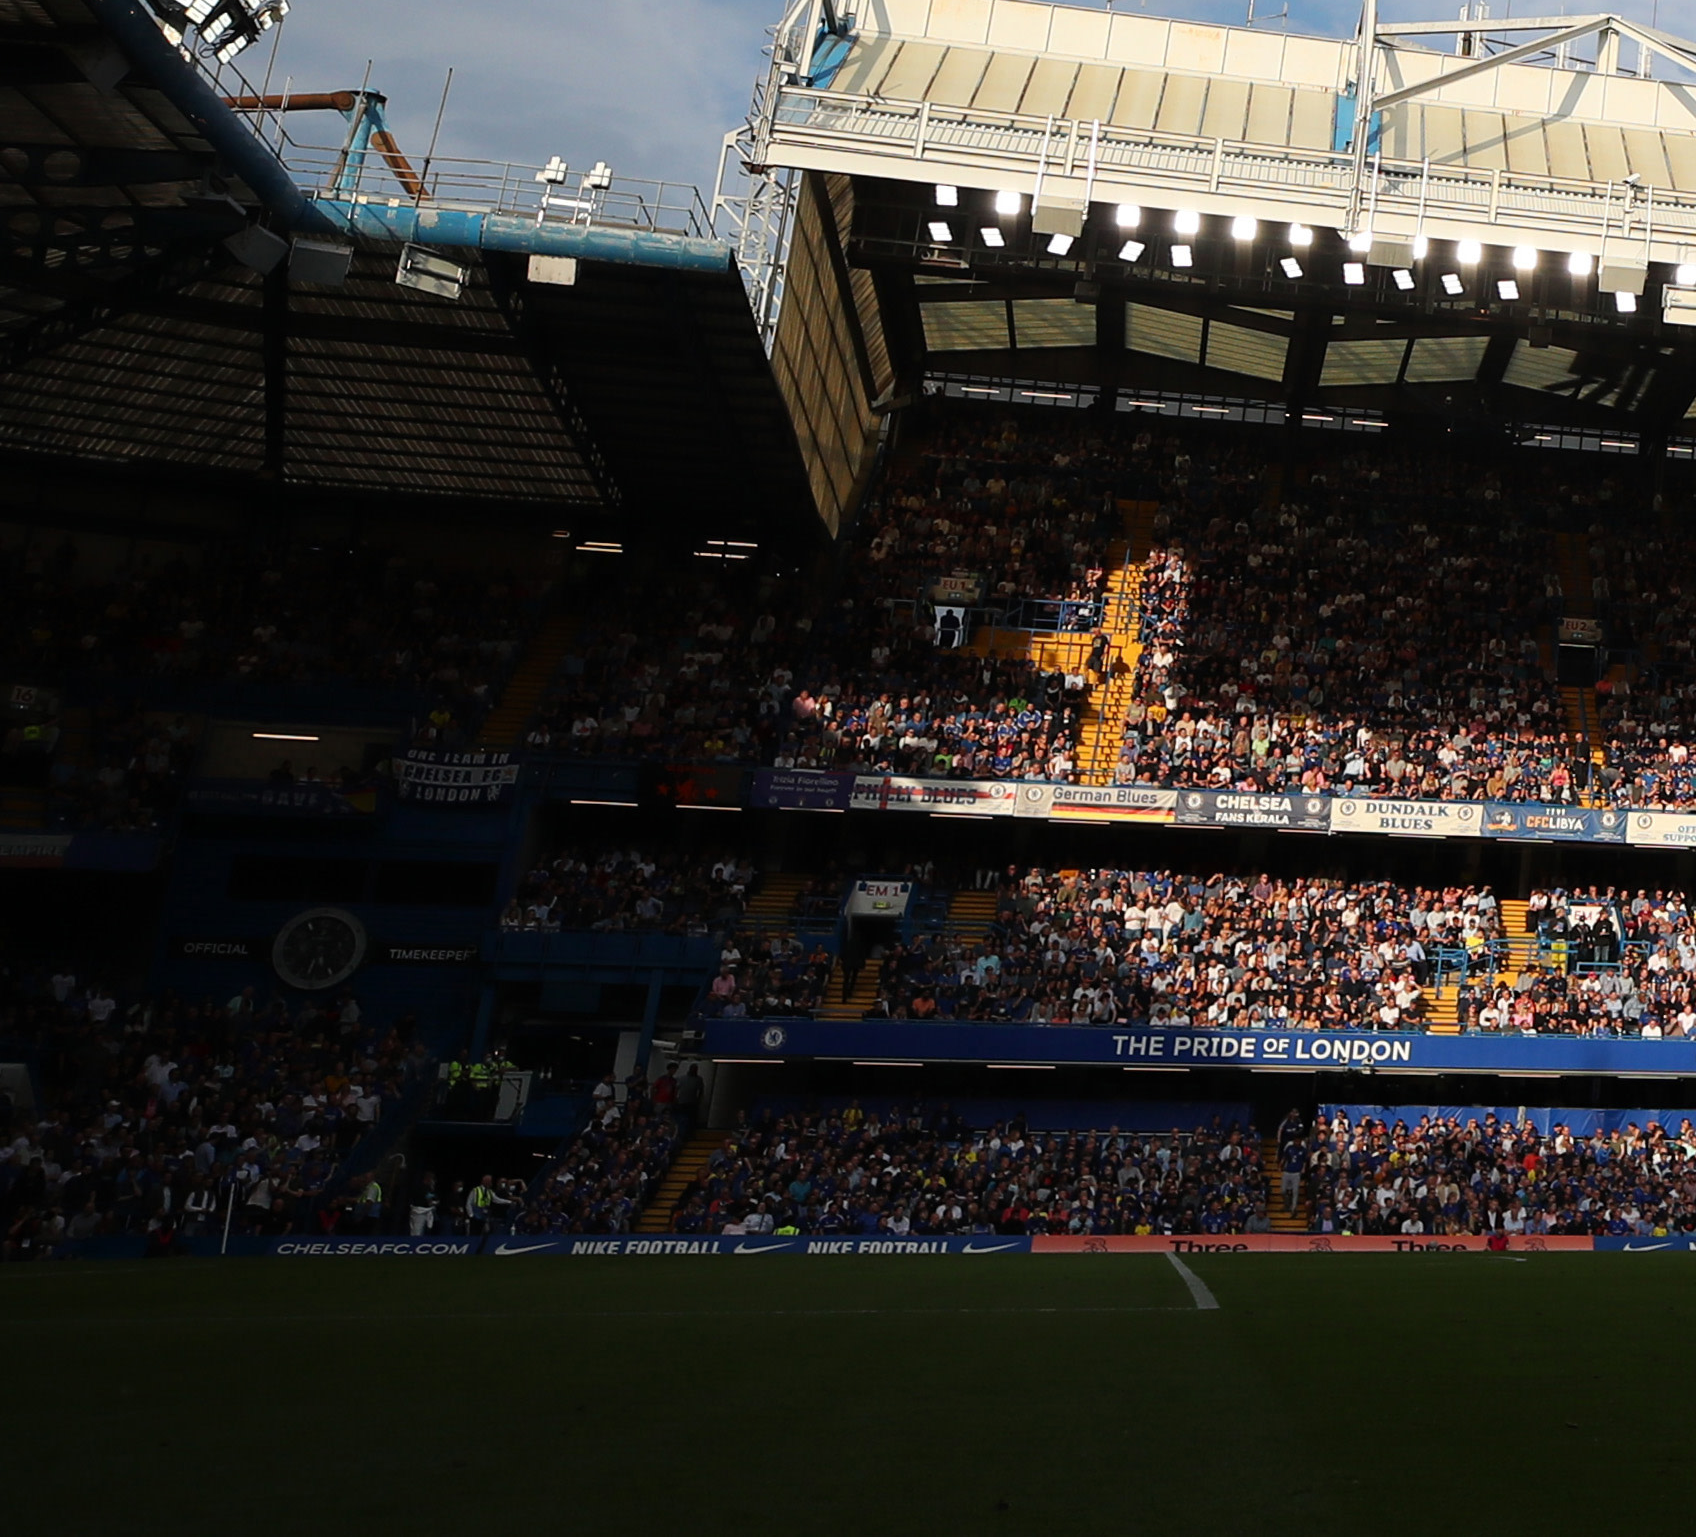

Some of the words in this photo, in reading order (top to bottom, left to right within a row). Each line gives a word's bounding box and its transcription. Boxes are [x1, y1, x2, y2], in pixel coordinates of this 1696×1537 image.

[15, 688, 33, 701] 16
[404, 765, 472, 783] CHELSEA
[482, 769, 501, 781] FC
[415, 786, 480, 801] LONDON
[920, 786, 977, 804] BLUES
[1053, 787, 1110, 803] German
[1115, 789, 1157, 804] Blues
[1215, 795, 1292, 812] CHELSEA
[1365, 803, 1450, 817] DUNDALK
[1215, 813, 1245, 824] FANS
[1248, 813, 1290, 825] KERALA
[1379, 819, 1433, 830] BLUES
[867, 885, 888, 896] EM
[893, 886, 898, 896] 1
[184, 942, 248, 955] OFFICIAL
[1112, 1035, 1164, 1056] THE
[1173, 1036, 1256, 1058] PRIDE
[1263, 1038, 1290, 1058] OF
[1295, 1039, 1411, 1061] LONDON
[277, 1243, 470, 1255] CHELSEAFC.COM
[571, 1241, 619, 1255] NIKE
[625, 1241, 721, 1255] FOOTBALL
[807, 1241, 853, 1254] NIKE
[857, 1241, 949, 1254] FOOTBALL
[1169, 1241, 1248, 1252] Three
